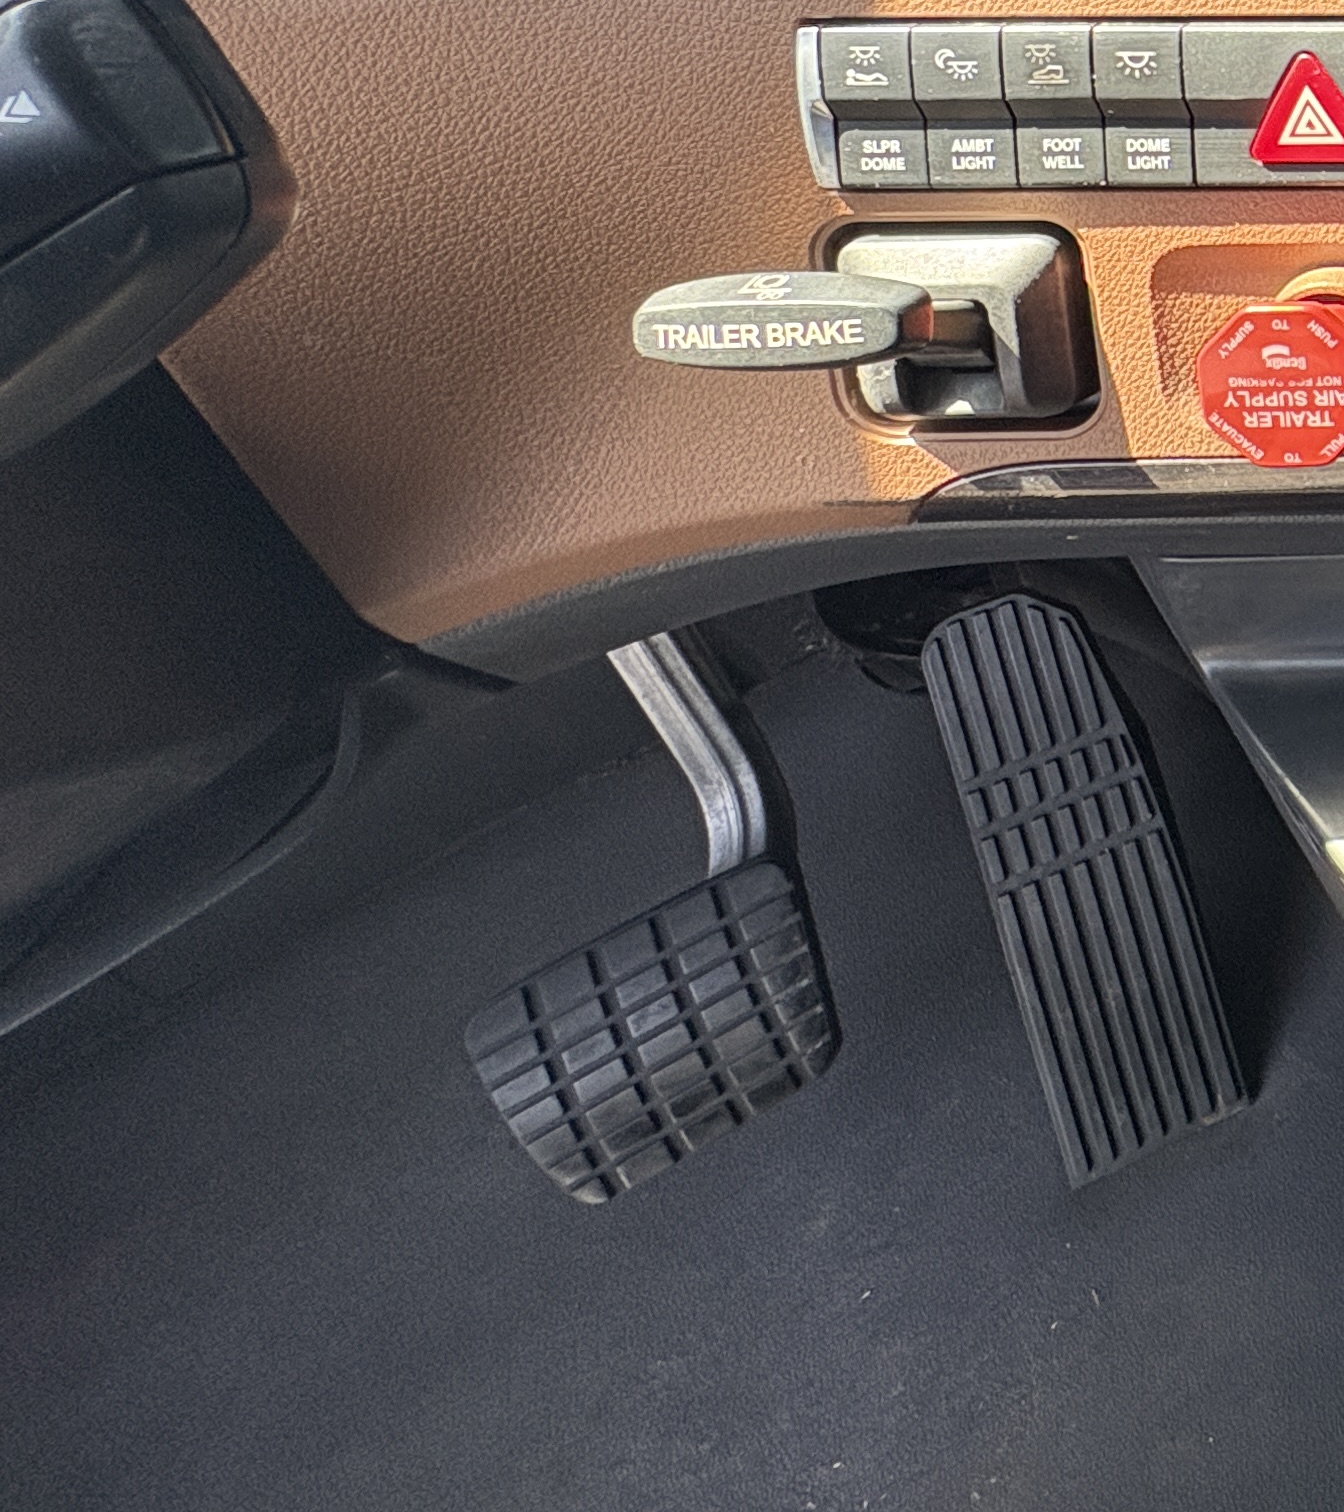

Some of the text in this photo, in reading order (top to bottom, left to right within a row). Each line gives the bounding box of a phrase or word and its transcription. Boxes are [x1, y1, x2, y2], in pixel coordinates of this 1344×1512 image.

[862, 139, 901, 154] SLPR
[951, 138, 995, 153] AMBT
[1042, 138, 1083, 152] FOOT
[1125, 138, 1172, 153] DOME
[861, 157, 907, 172] DOME
[951, 156, 997, 171] LIGHT
[1042, 155, 1085, 170] WELL
[1127, 155, 1172, 170] LIGHT
[651, 317, 865, 351] TRAILER BRAKE
[1217, 318, 1339, 360] PUSH TO SUPPLY
[1314, 375, 1343, 388] NOT
[1223, 389, 1309, 408] SUPPLY
[1242, 409, 1336, 429] TRAILER
[1207, 411, 1265, 461] EVACUATE
[1283, 452, 1303, 464] TO
